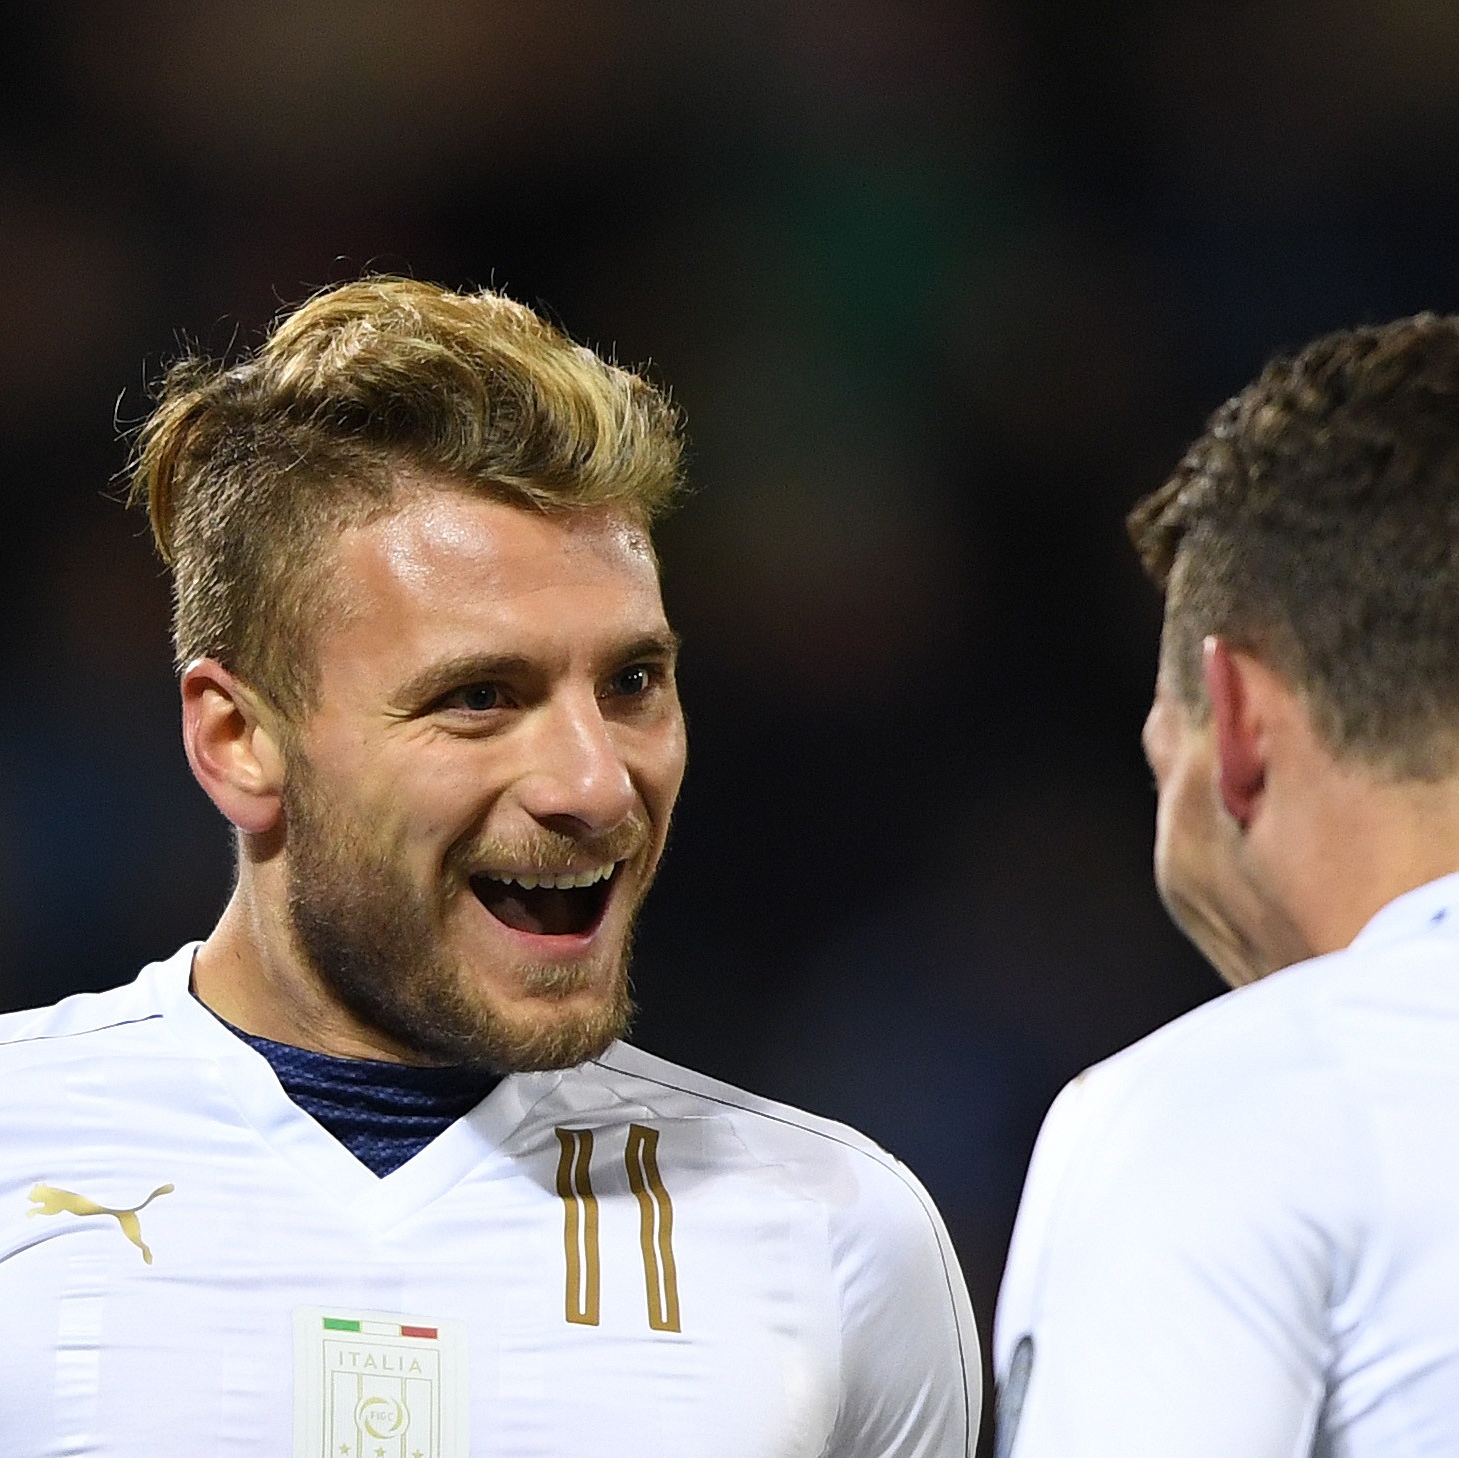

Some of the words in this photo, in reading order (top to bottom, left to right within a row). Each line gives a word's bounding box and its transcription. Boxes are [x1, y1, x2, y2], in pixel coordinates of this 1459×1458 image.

[555, 1123, 681, 1333] 11
[339, 1350, 423, 1374] ITALIA
[370, 1410, 394, 1422] FIGC
